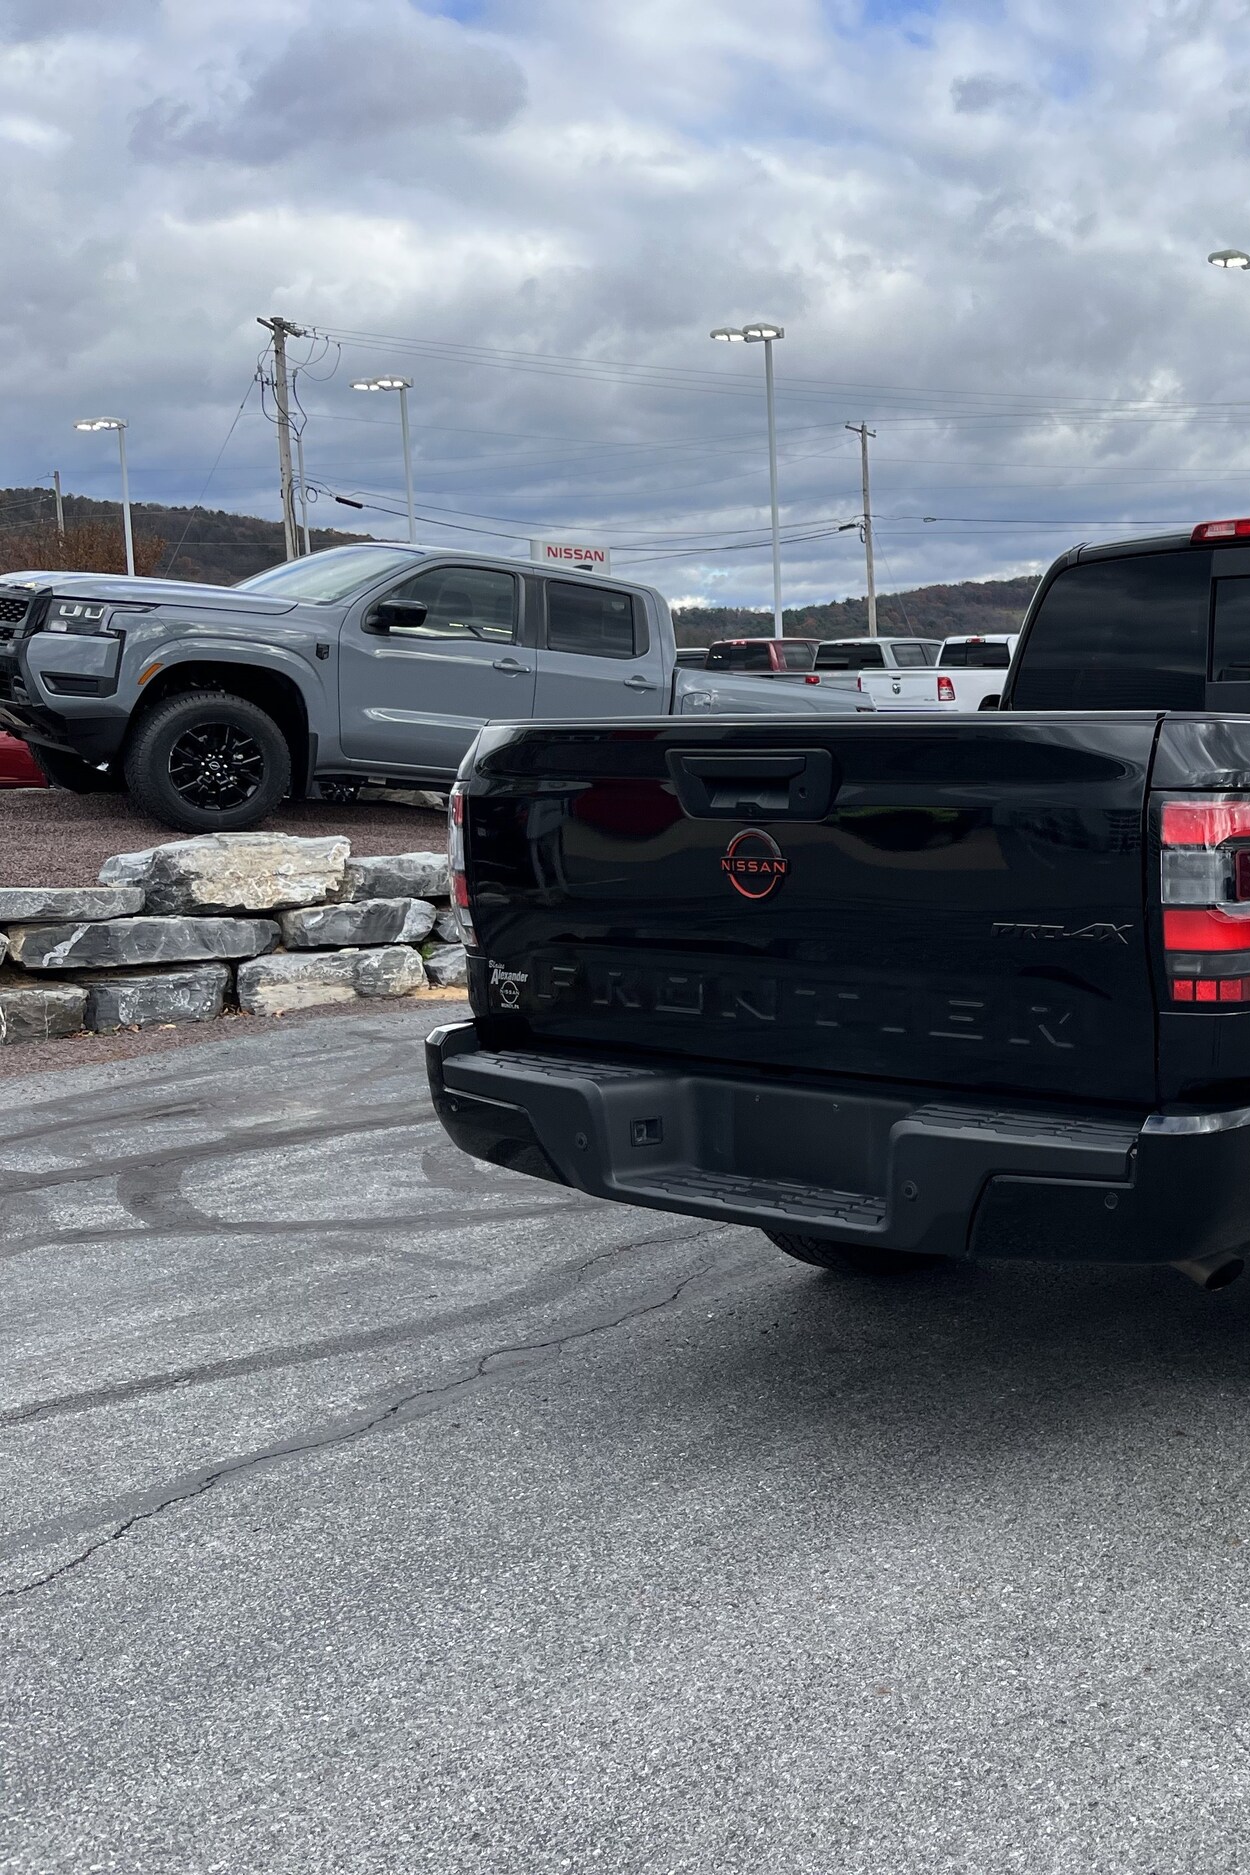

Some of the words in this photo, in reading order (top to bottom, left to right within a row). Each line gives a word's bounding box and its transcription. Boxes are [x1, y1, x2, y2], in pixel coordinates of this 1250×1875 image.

[547, 546, 604, 562] NISSAN
[721, 860, 785, 873] NISSAN
[490, 968, 528, 984] Alexander
[538, 963, 1075, 1048] FRONTIER
